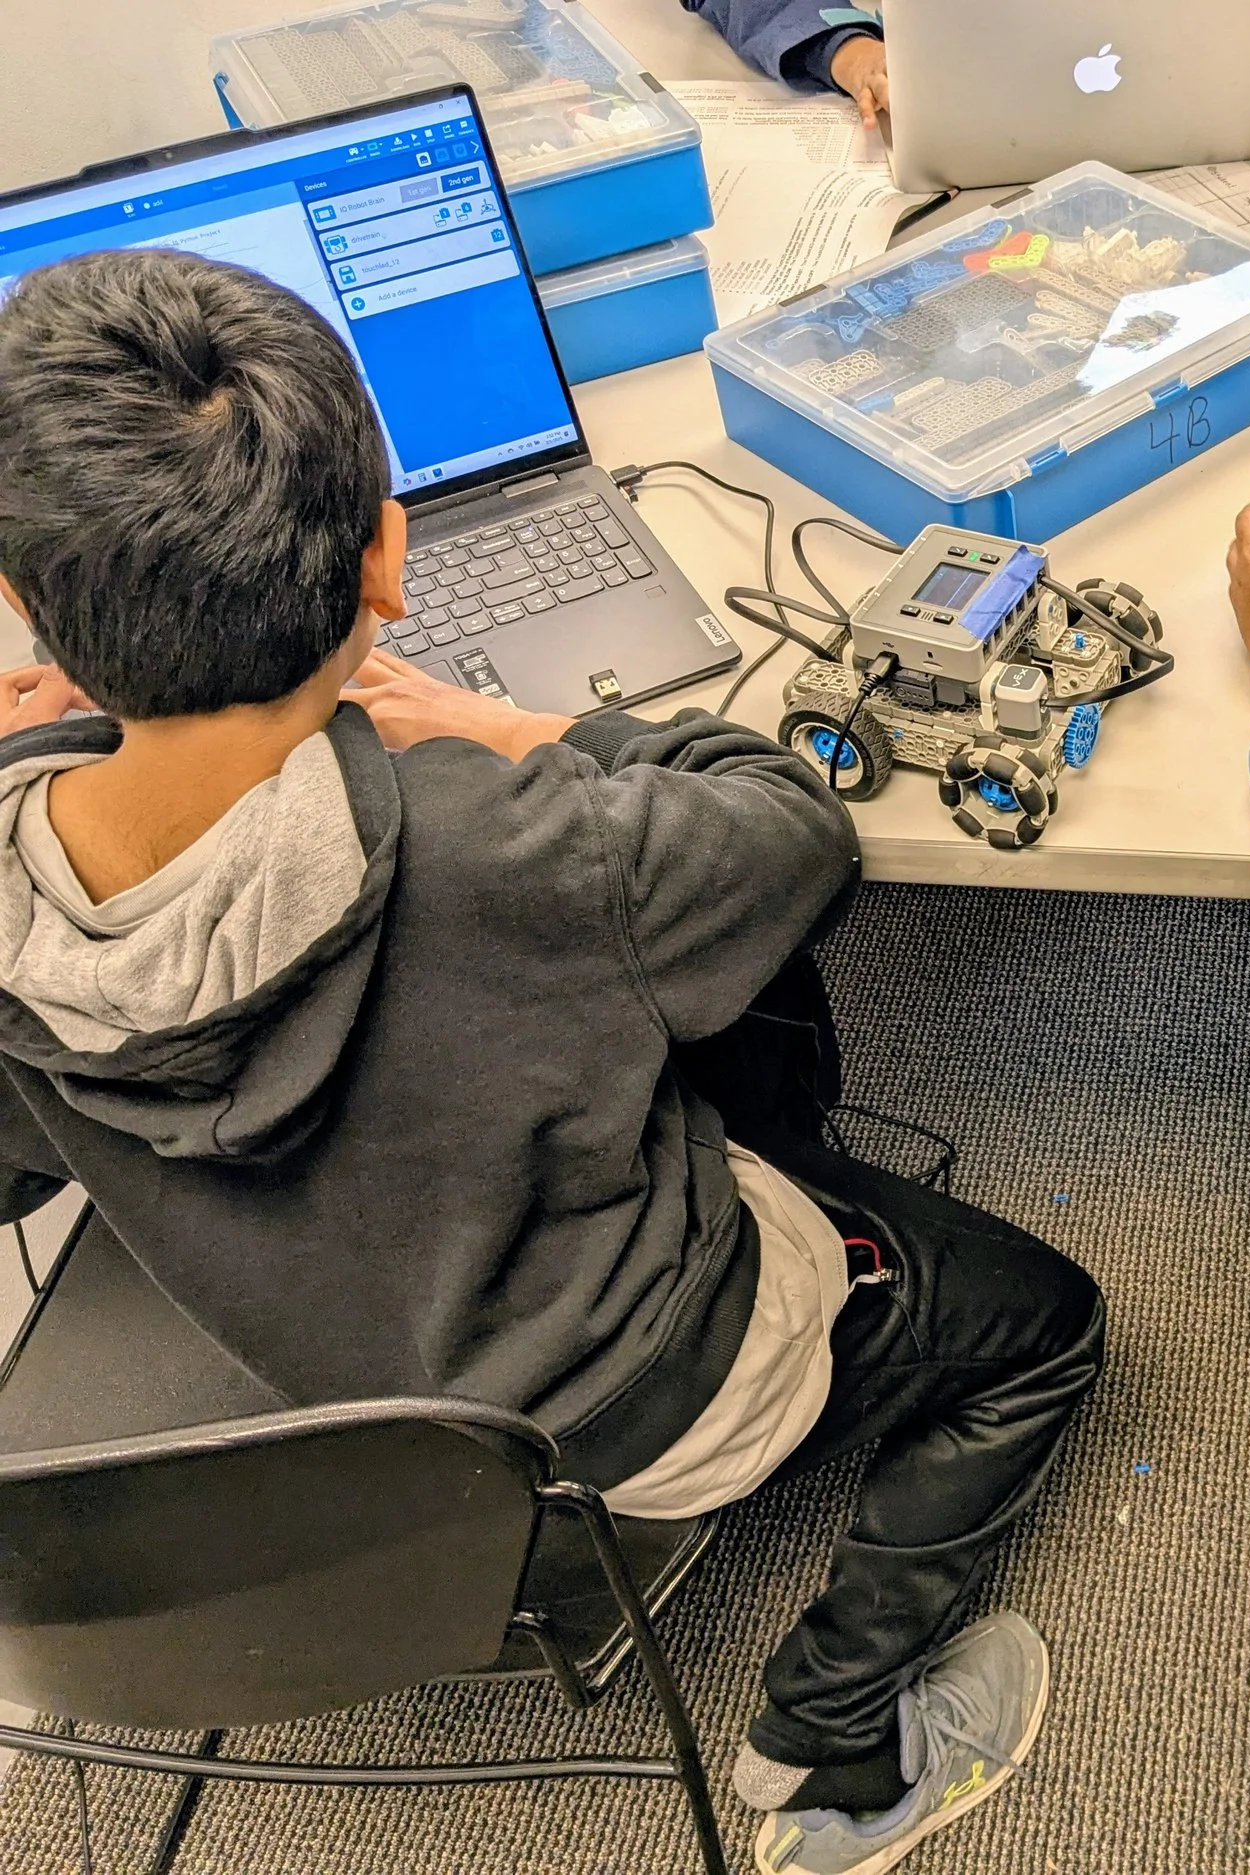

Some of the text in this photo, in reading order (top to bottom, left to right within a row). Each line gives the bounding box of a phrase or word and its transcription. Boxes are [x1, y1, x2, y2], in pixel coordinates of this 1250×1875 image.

[493, 232, 502, 240] 12
[1150, 396, 1211, 464] 4B
[703, 618, 725, 643] Lenovo
[1012, 668, 1028, 687] VEX
